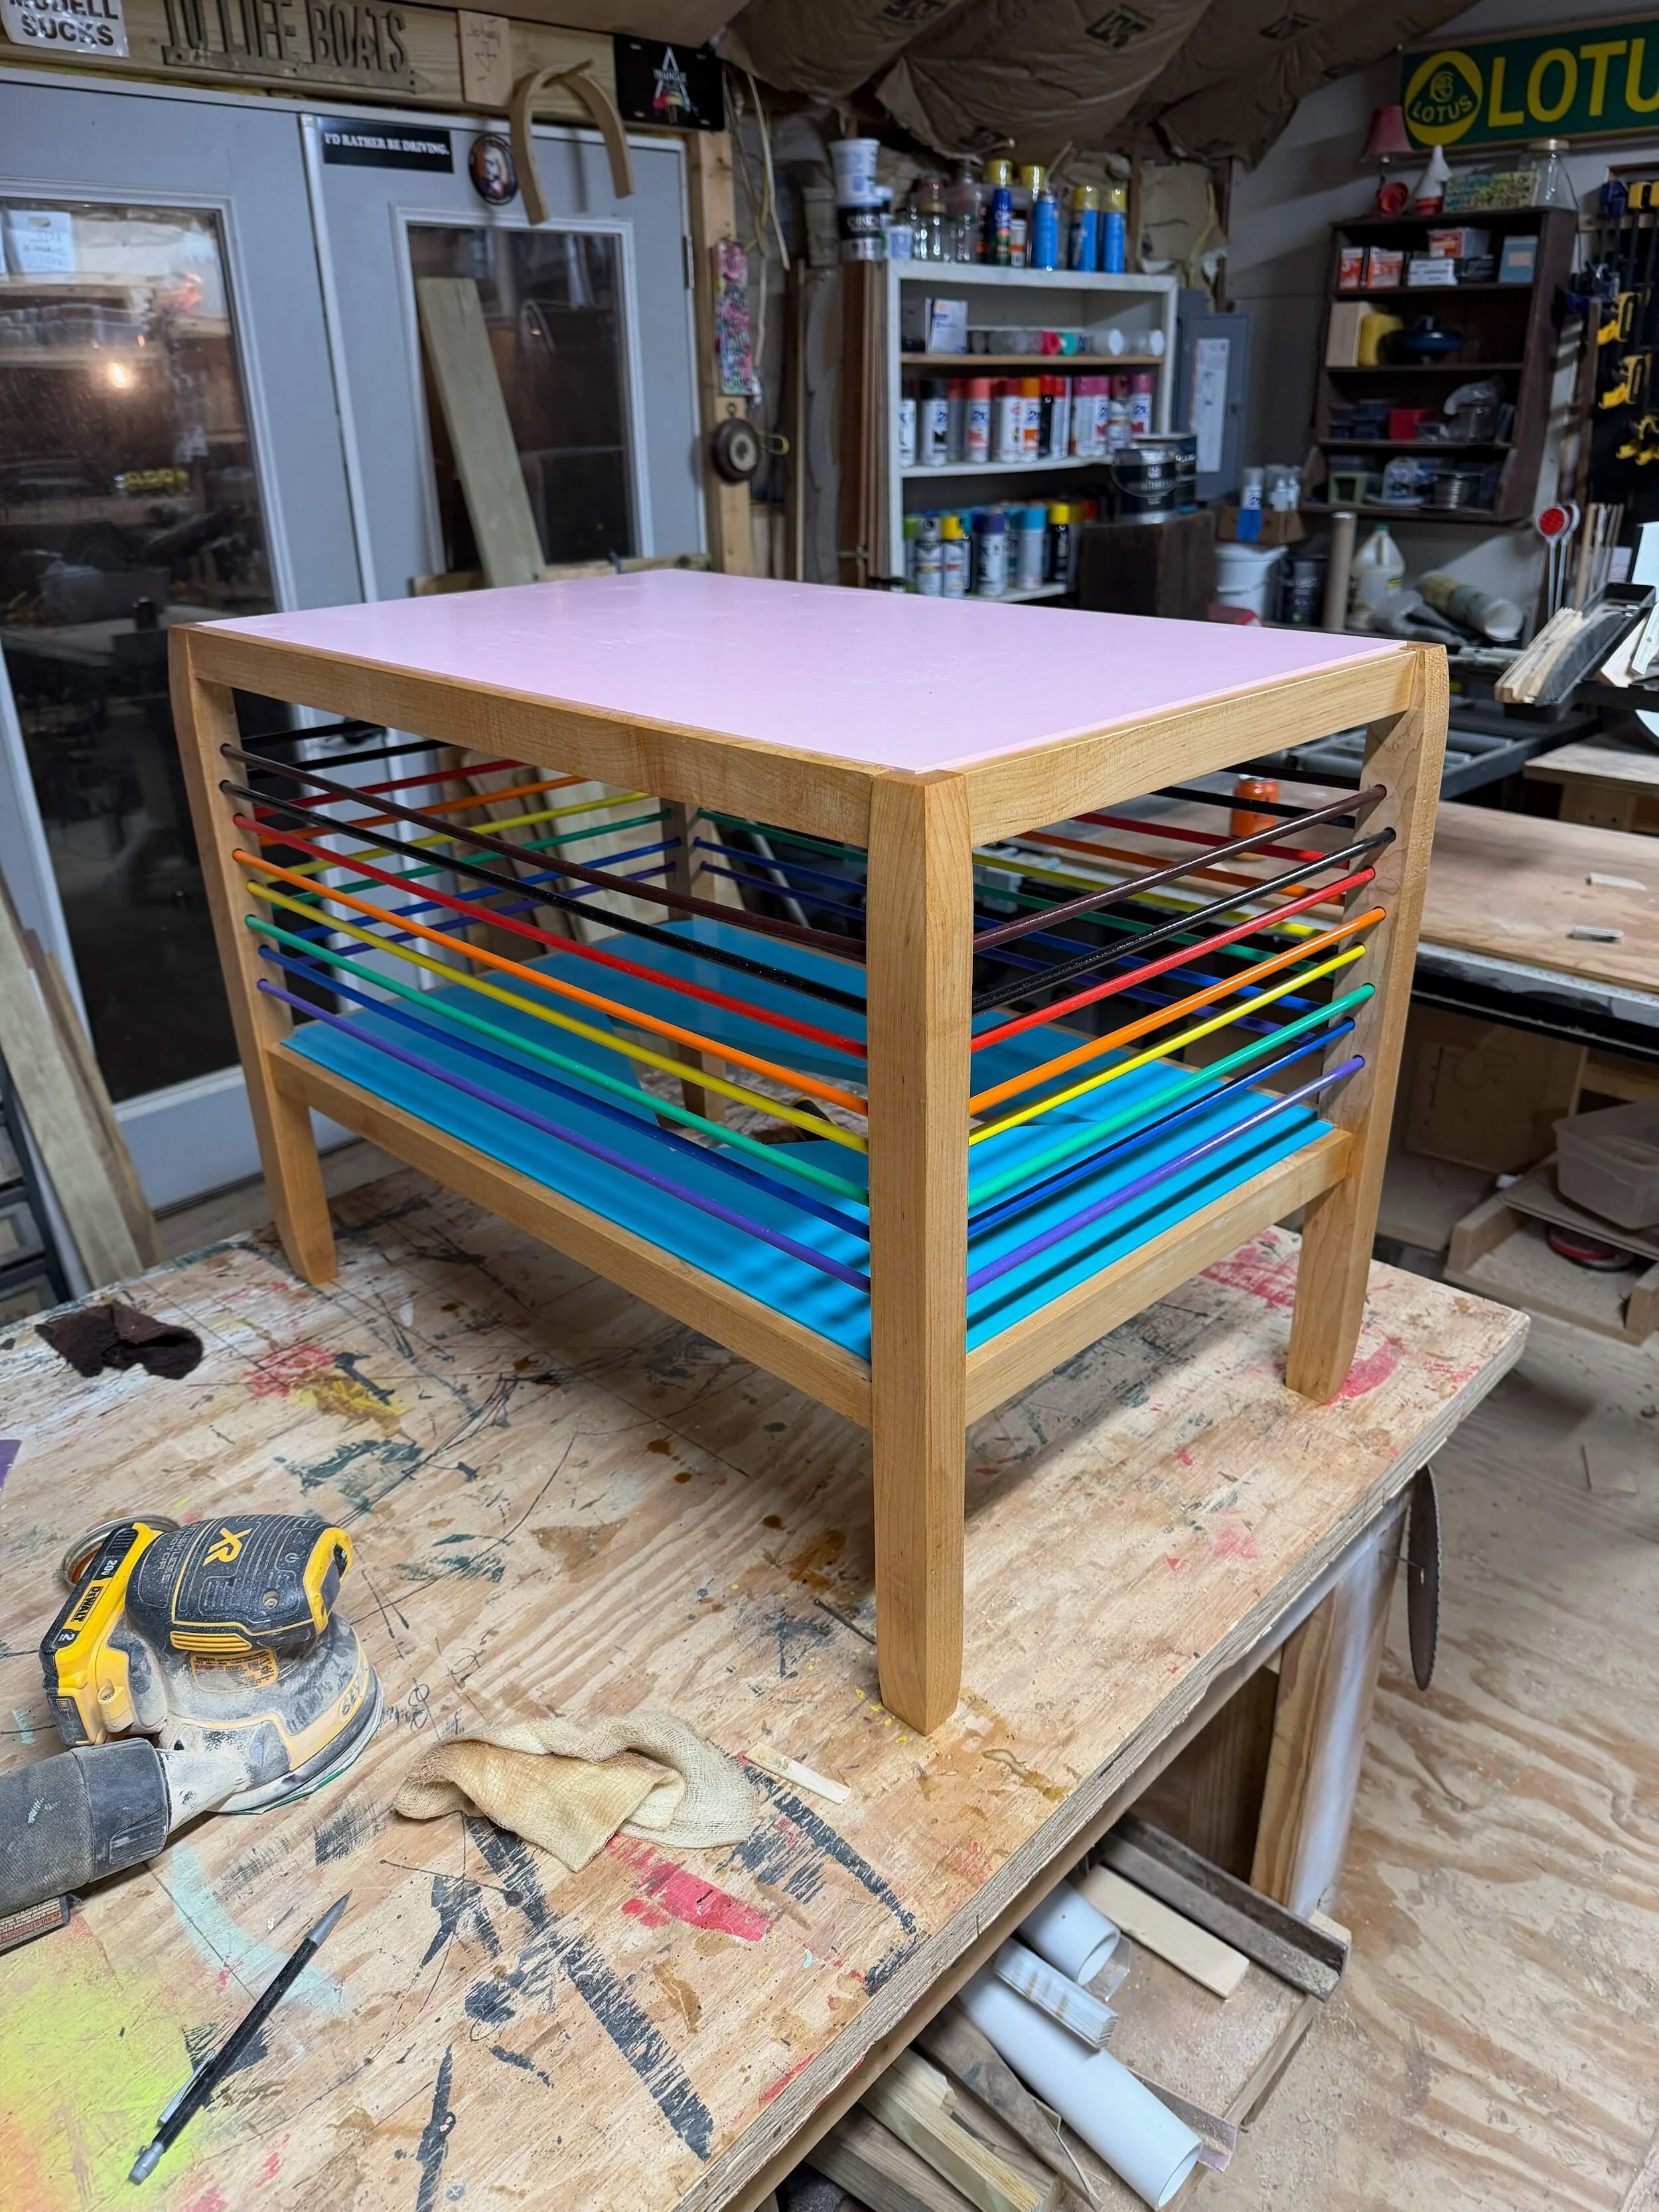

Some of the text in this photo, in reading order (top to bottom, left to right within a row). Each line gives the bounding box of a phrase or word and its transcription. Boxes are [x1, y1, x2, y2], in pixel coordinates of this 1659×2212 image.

[21, 13, 114, 46] SUCKS
[306, 0, 407, 72] BOATS
[1411, 94, 1474, 123] LOTUS
[324, 133, 340, 145] I'D
[341, 134, 386, 150] RATHER
[386, 138, 402, 151] BE
[202, 1527, 253, 1566] XR
[100, 1559, 118, 1576] 20V
